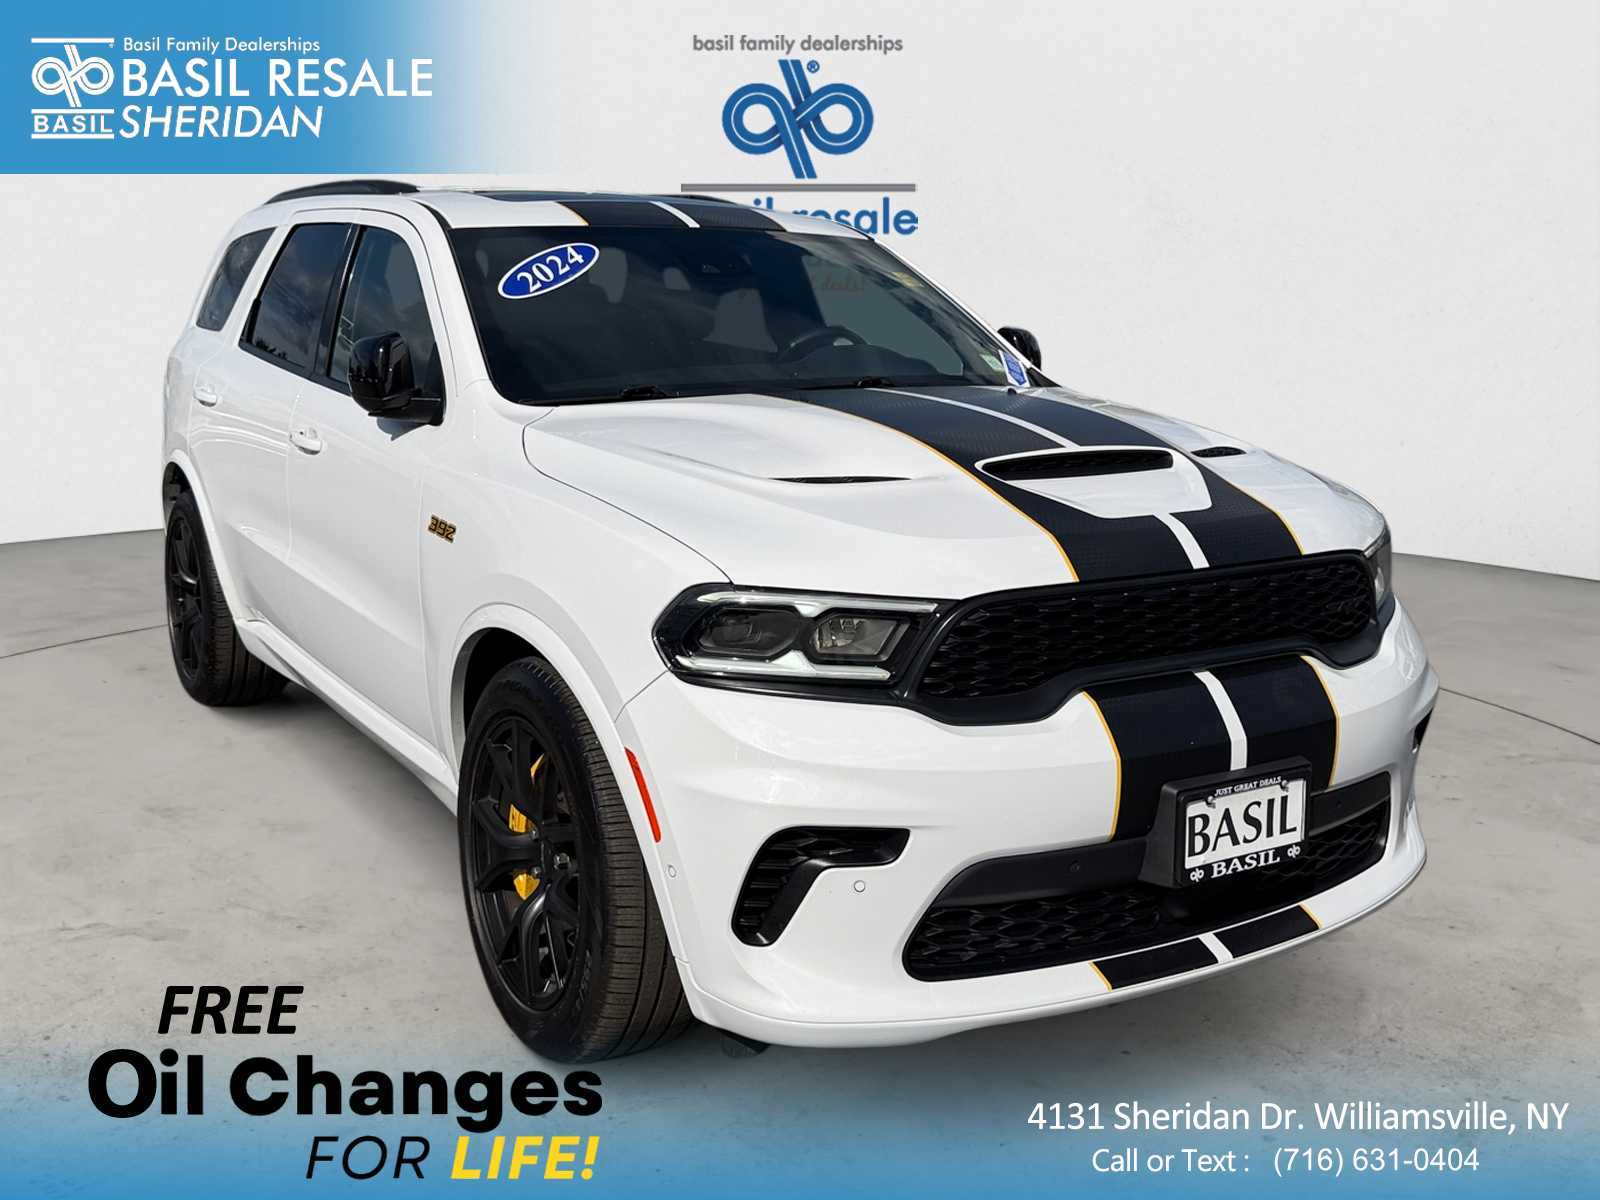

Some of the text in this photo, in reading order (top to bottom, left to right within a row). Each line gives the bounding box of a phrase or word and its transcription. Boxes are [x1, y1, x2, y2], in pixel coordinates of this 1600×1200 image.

[692, 35, 904, 55] basil family dealerships
[793, 197, 918, 235] sale
[516, 246, 585, 293] 2024
[428, 514, 457, 543] 392
[1214, 775, 1282, 797] JUST GREAT DEALS
[1187, 794, 1297, 858] BASIL
[1210, 849, 1281, 878] BASIL
